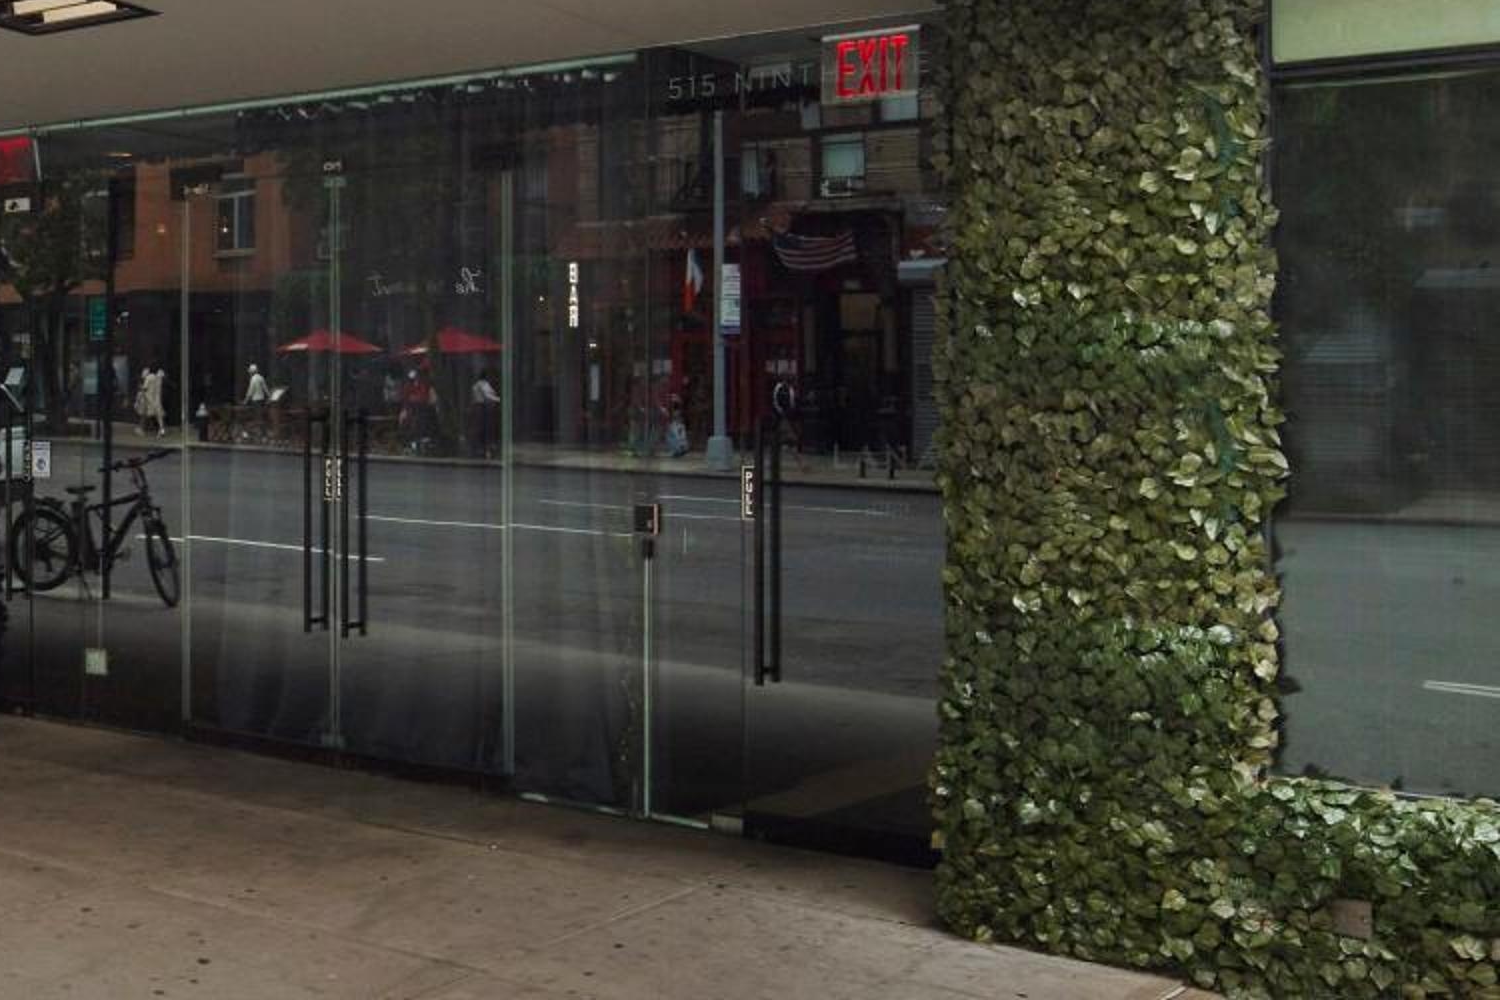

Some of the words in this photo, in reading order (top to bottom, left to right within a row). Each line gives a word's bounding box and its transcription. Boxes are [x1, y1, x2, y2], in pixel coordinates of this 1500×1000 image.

[667, 73, 716, 99] 515
[836, 34, 910, 98] EXIT
[745, 471, 753, 515] PULL
